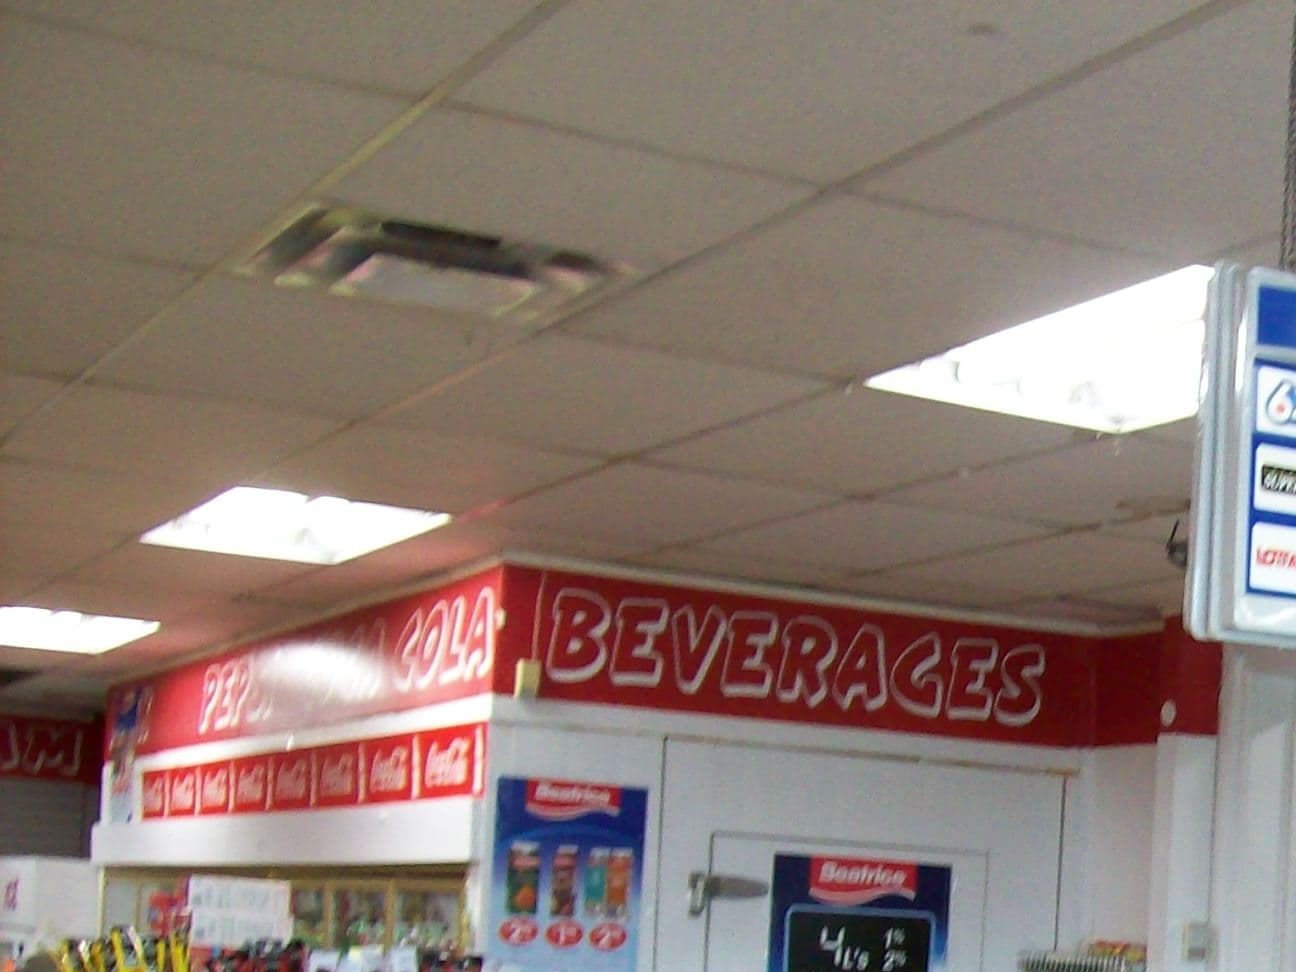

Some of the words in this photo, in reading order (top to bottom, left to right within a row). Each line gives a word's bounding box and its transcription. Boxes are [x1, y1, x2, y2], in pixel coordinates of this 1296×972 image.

[394, 585, 496, 695] COLA
[548, 588, 1046, 728] BEVERAGES
[818, 860, 907, 886] Beatrice
